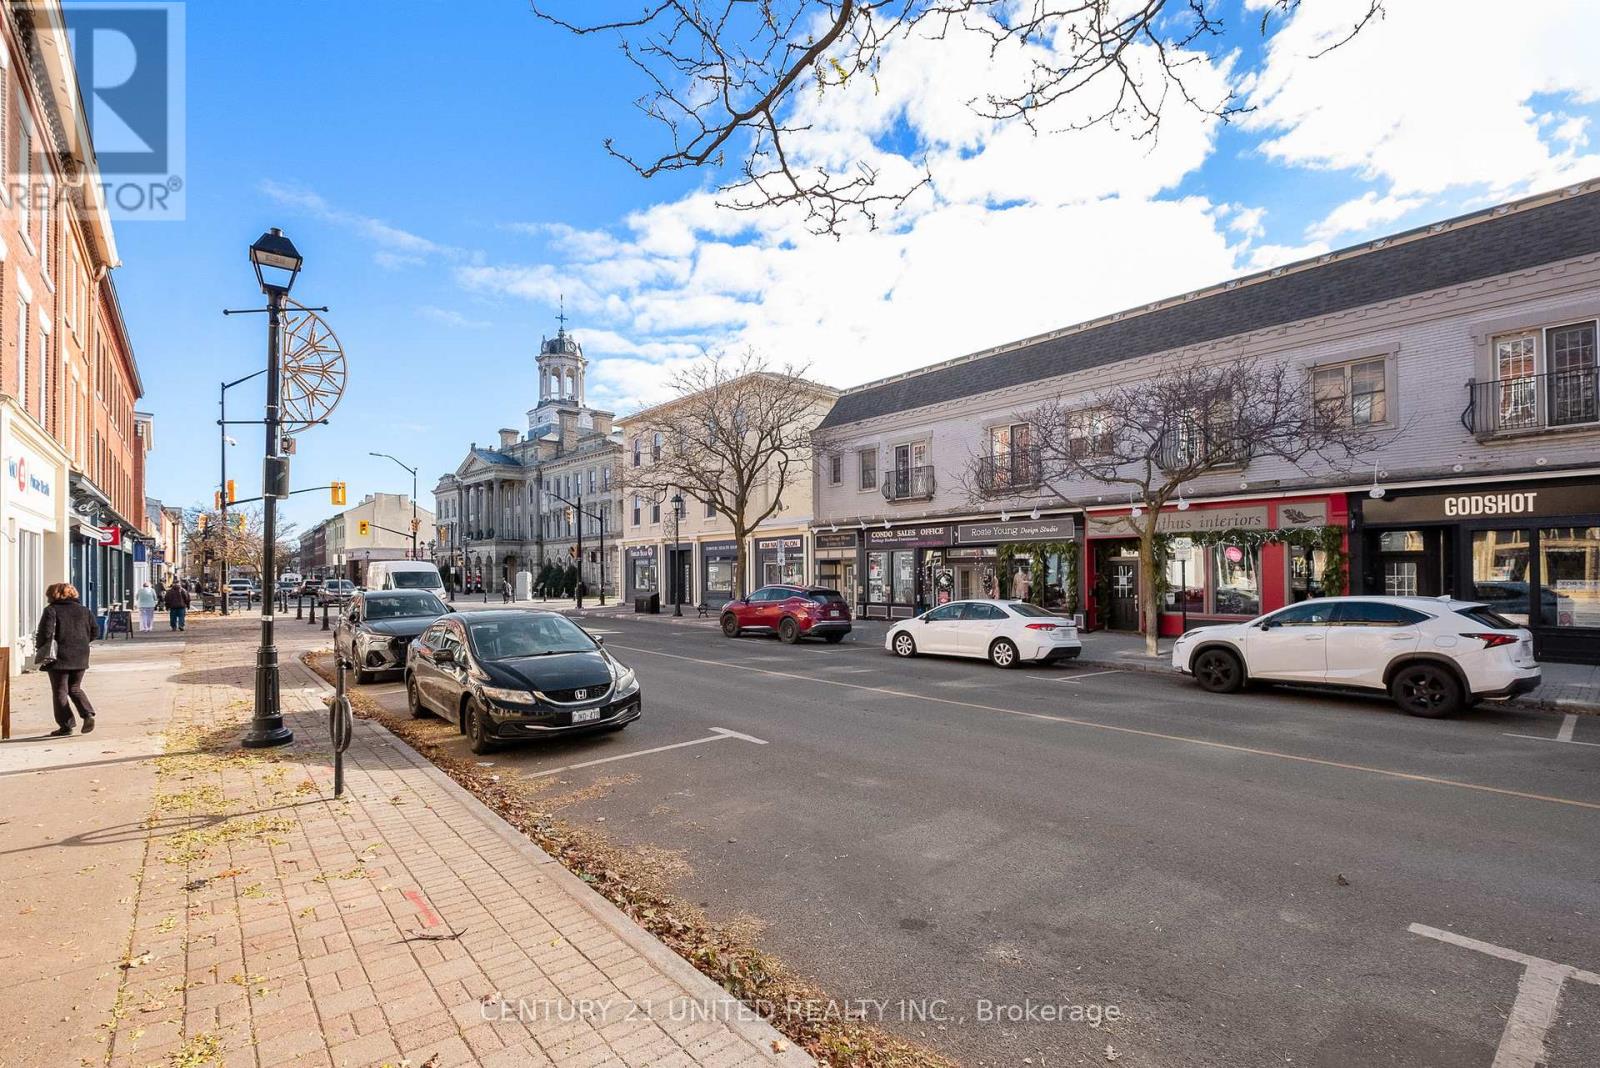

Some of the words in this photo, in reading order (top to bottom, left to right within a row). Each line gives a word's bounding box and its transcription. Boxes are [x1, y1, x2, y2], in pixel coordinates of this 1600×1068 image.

[1444, 492, 1538, 516] GODSHOT
[1200, 512, 1261, 528] interiors
[871, 531, 893, 539] CONDO
[896, 529, 916, 537] SALES
[920, 527, 944, 536] OFFICE
[993, 526, 1018, 536] Young
